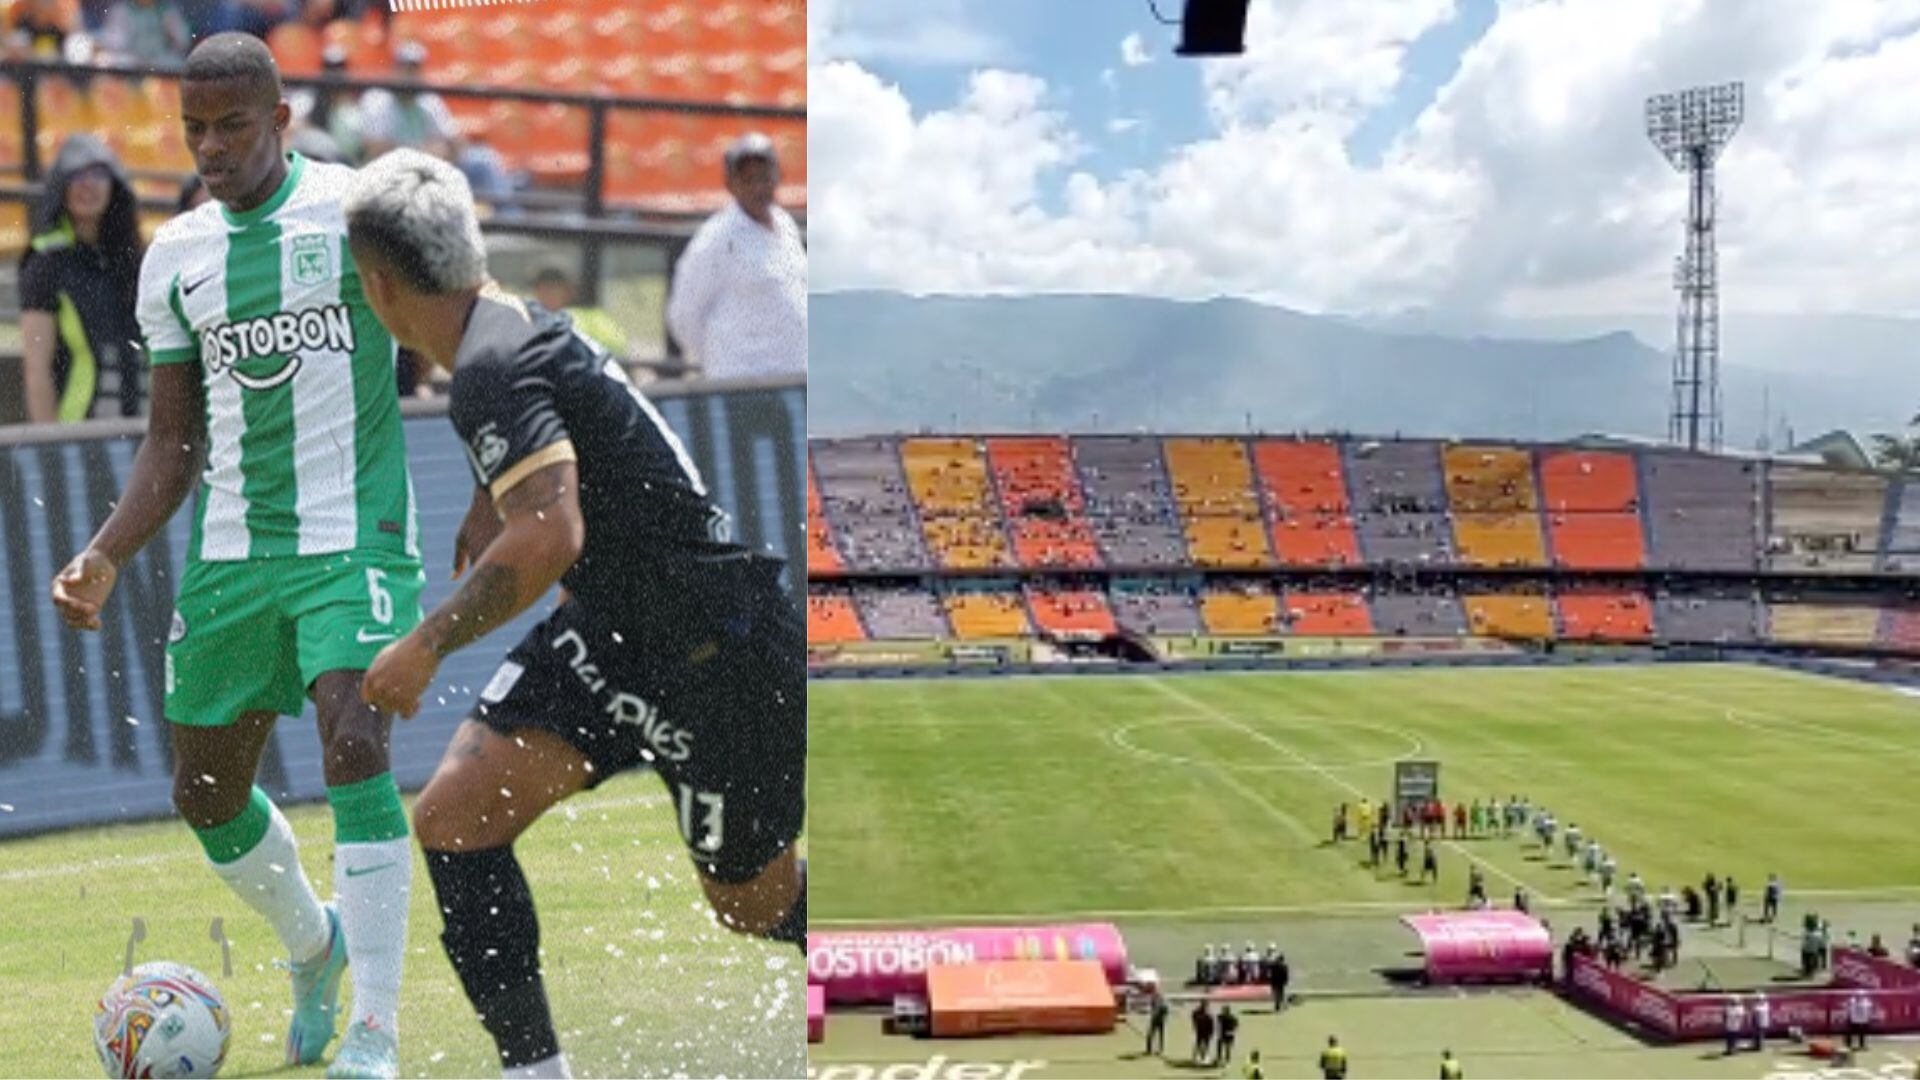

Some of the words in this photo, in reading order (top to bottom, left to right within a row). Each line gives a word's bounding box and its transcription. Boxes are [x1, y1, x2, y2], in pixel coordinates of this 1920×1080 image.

[201, 304, 355, 372] OSTOBON
[366, 567, 394, 625] 6
[679, 783, 724, 851] 13
[808, 941, 975, 979] OSTOBON
